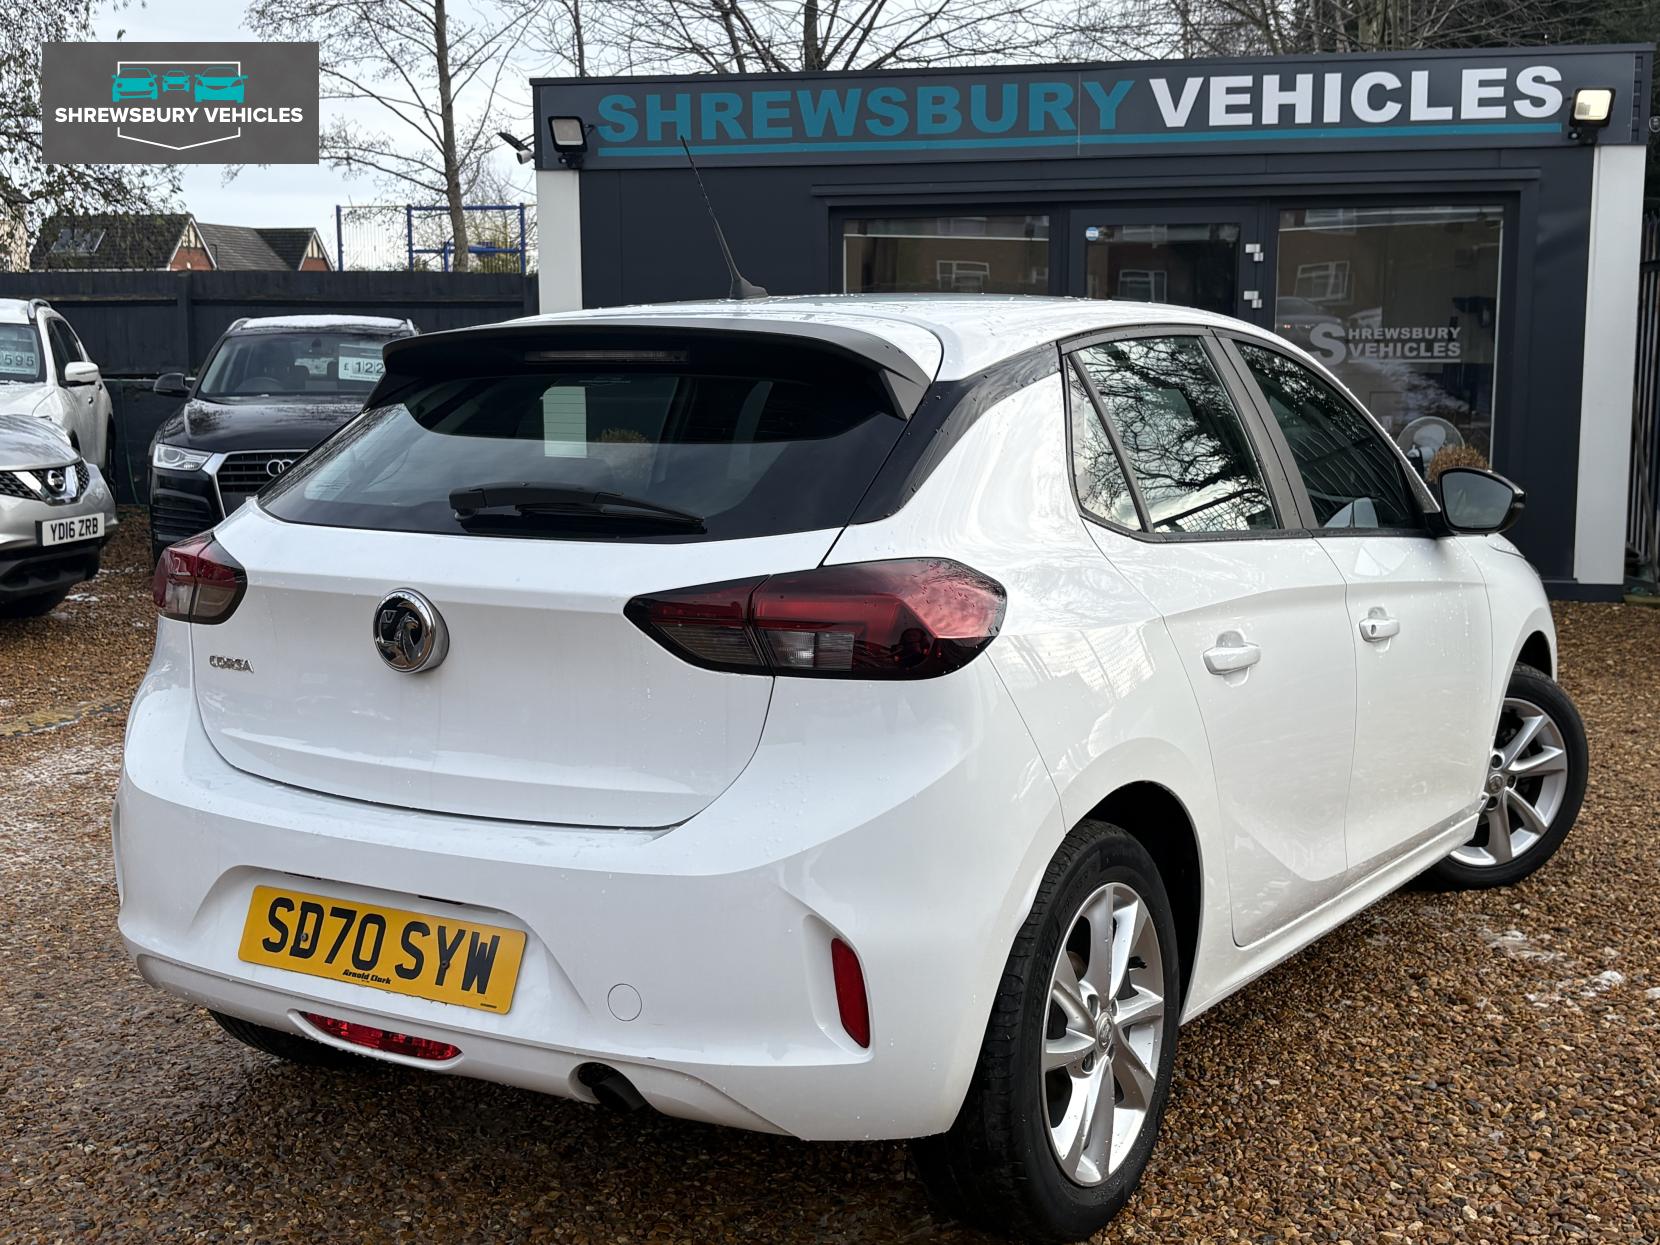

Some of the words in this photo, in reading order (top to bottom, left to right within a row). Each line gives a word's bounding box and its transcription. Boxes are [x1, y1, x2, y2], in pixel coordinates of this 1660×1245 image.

[597, 79, 1136, 143] SHREWSBURY
[1149, 65, 1564, 129] VEHICLES
[1310, 322, 1461, 365] SHREWSBURY
[1348, 342, 1461, 357] VEHICLES
[0, 353, 34, 367] 595
[50, 520, 76, 542] YD16
[78, 517, 99, 537] ZRB
[262, 896, 387, 972] SD70
[394, 920, 501, 995] SYW
[342, 969, 370, 980] Arnold
[370, 974, 392, 985] Clark
